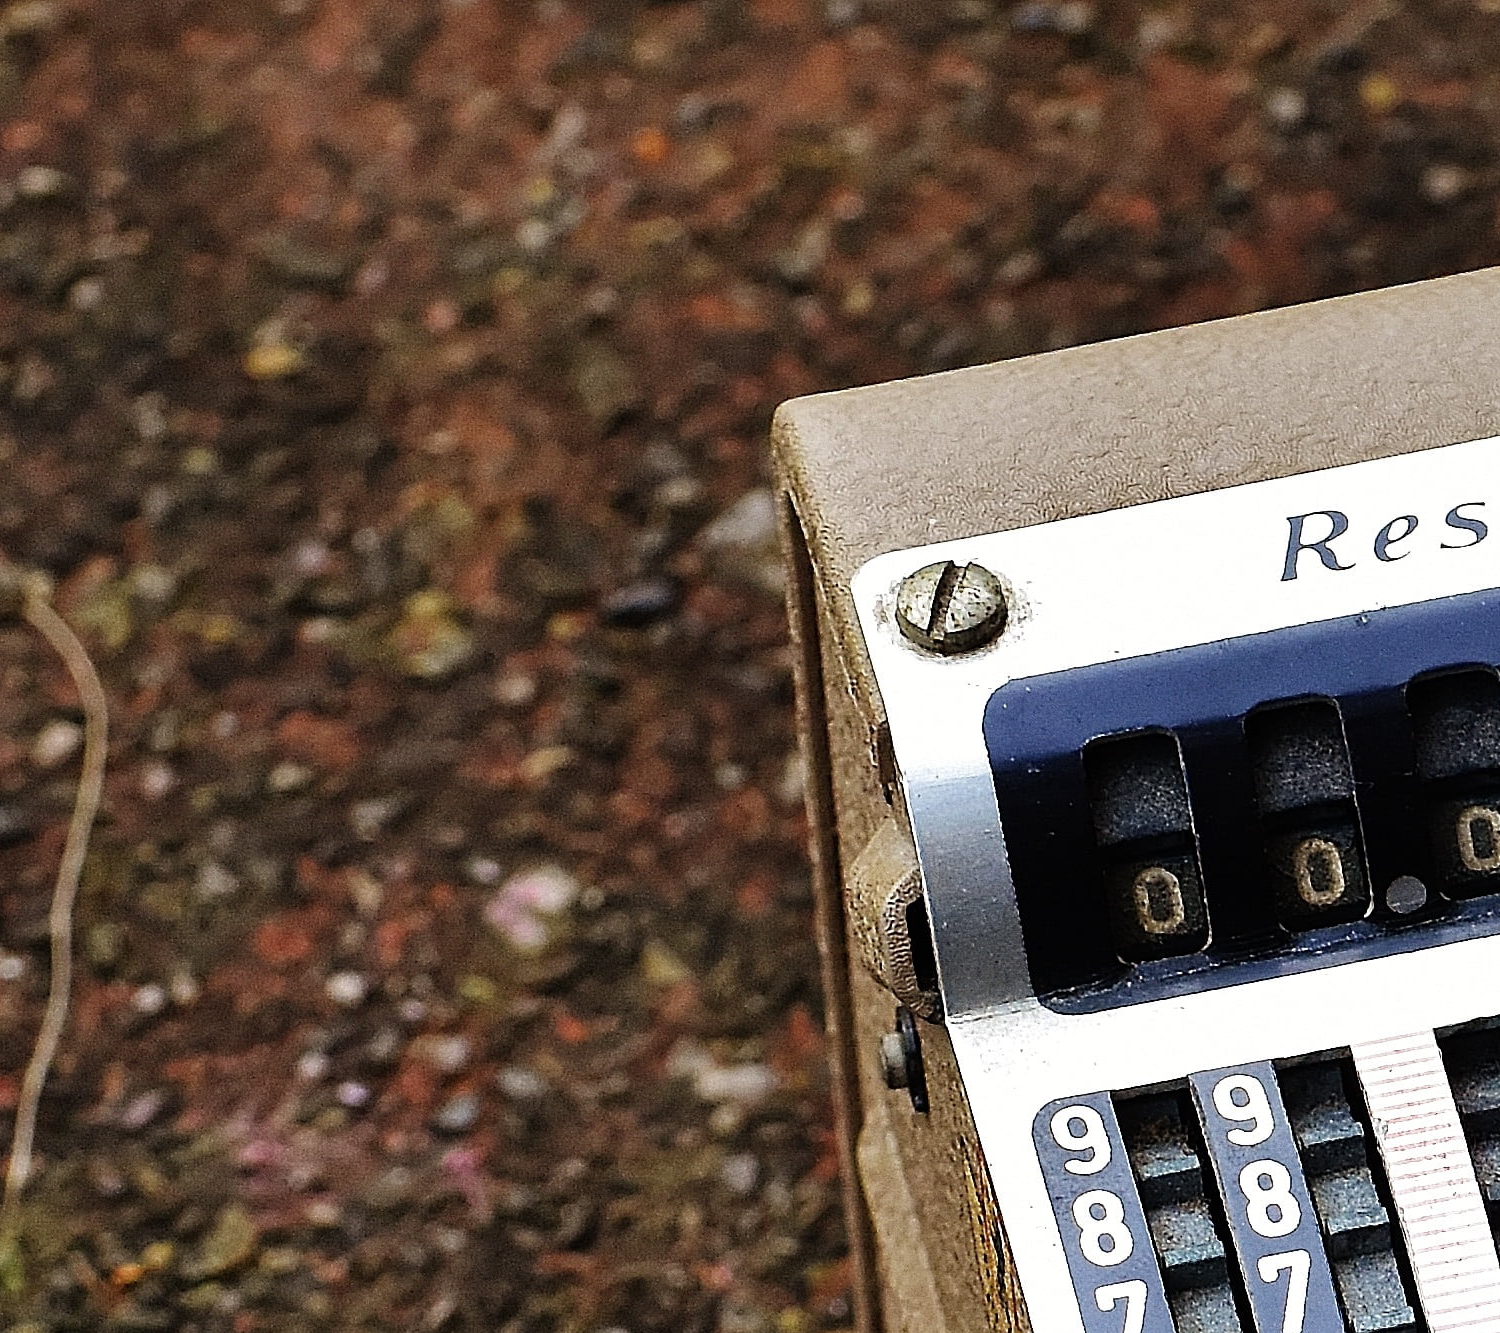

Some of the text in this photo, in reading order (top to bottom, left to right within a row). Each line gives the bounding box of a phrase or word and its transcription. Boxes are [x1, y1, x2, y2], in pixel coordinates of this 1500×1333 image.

[1135, 866, 1185, 934] 0
[1297, 838, 1345, 906] 0
[1049, 1104, 1112, 1175] 9
[1212, 1073, 1274, 1146] 9
[1071, 1189, 1134, 1267] 8
[1239, 1158, 1301, 1238] 8
